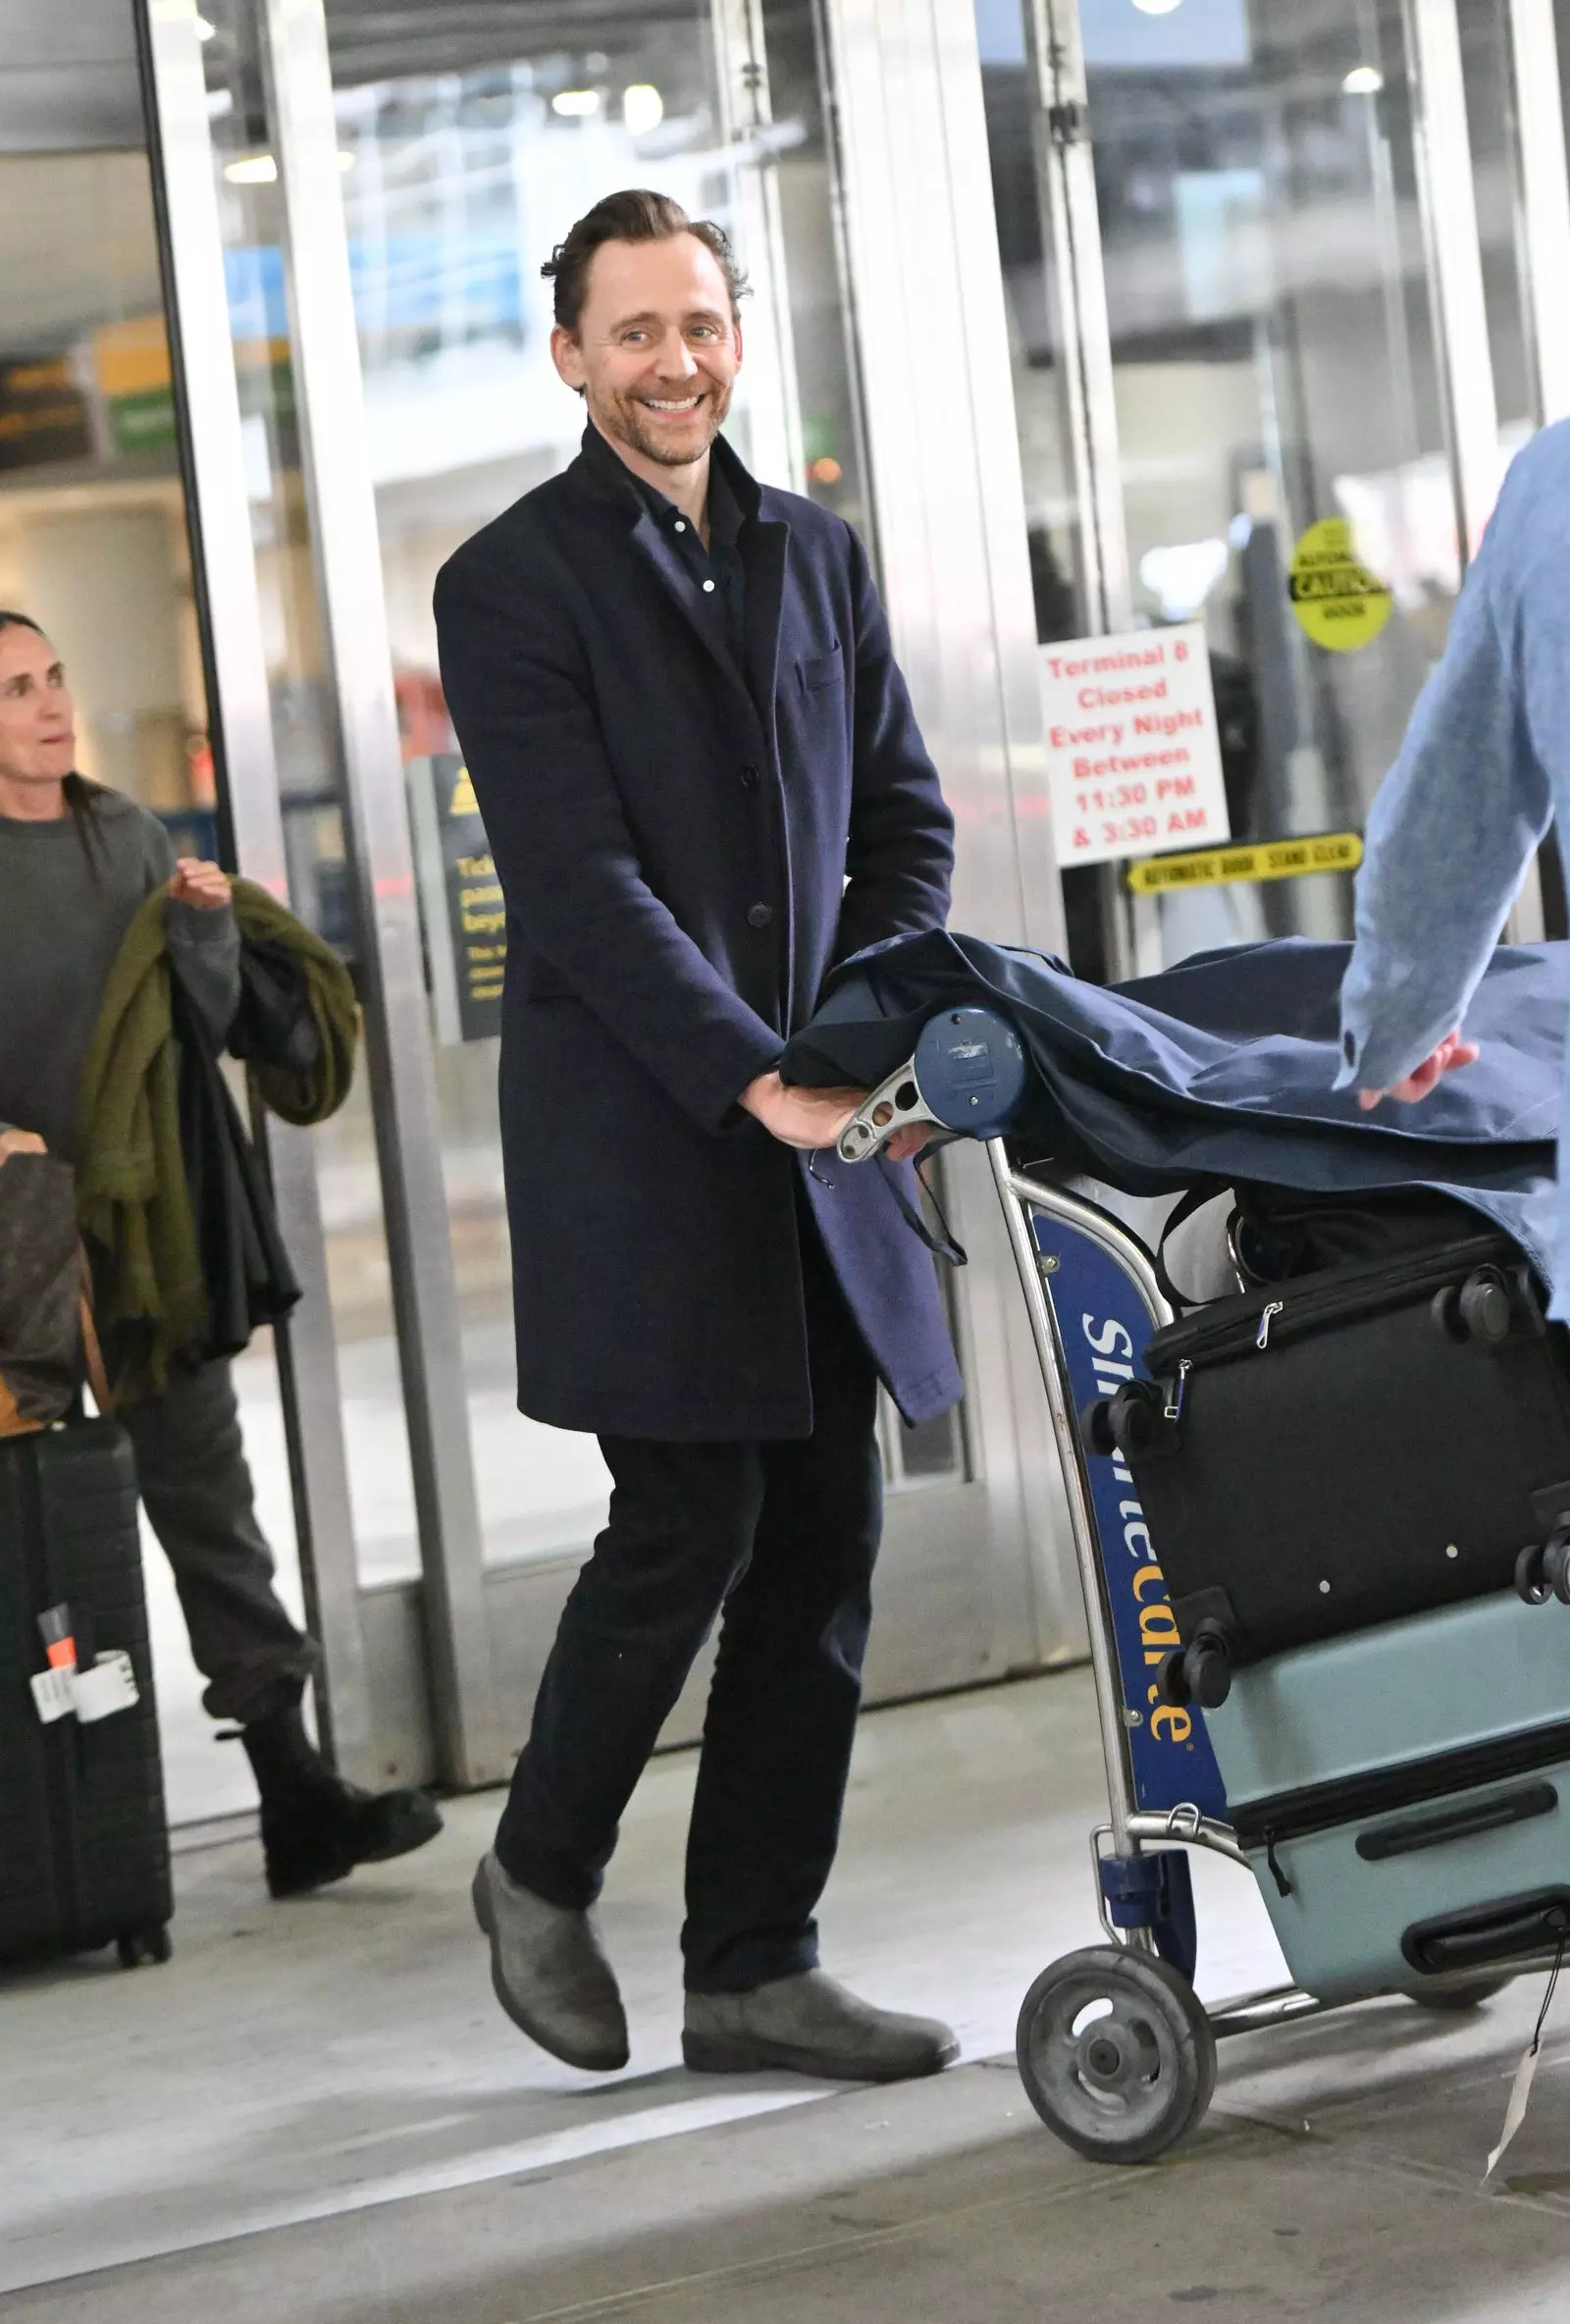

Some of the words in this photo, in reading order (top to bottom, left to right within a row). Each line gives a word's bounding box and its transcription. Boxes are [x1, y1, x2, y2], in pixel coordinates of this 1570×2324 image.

[1047, 644, 1164, 678] Terminal
[1077, 677, 1168, 710] Closed
[1049, 724, 1124, 748] Every
[1133, 708, 1202, 736] Night
[1073, 748, 1189, 778] Between
[1076, 782, 1146, 813] 11:30
[1157, 776, 1195, 799] PM
[1073, 826, 1091, 847] &
[1102, 816, 1157, 844] 3:30
[1168, 808, 1206, 832] AM
